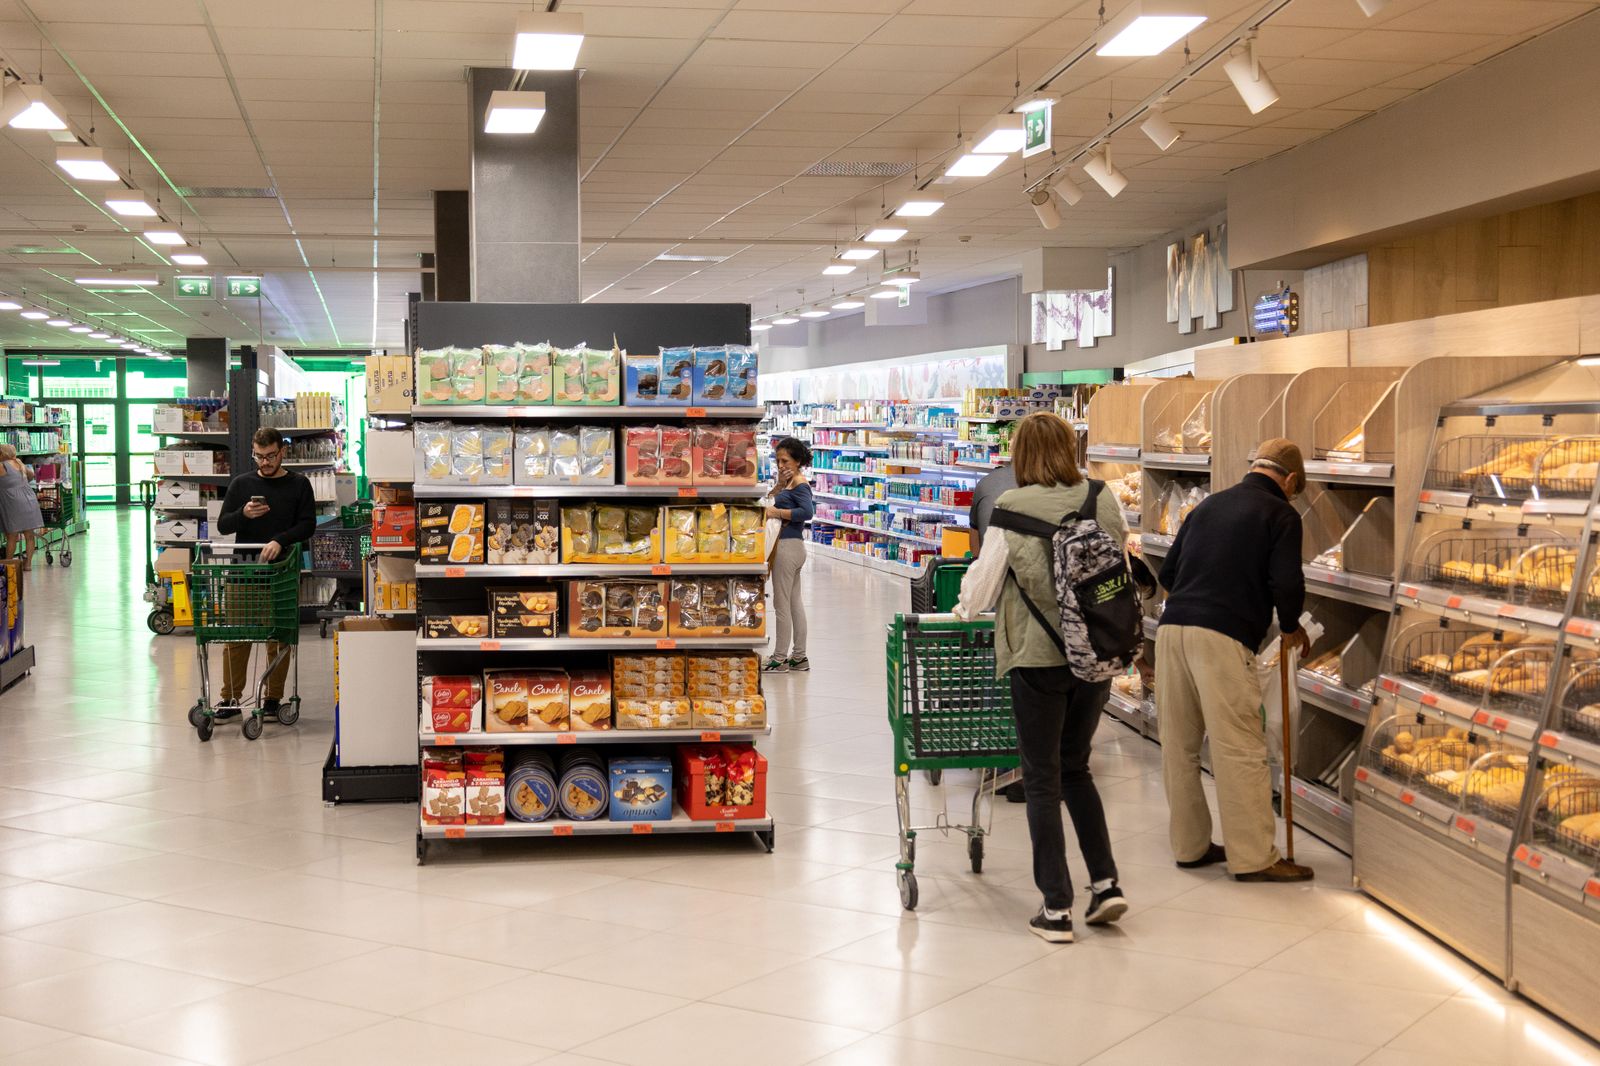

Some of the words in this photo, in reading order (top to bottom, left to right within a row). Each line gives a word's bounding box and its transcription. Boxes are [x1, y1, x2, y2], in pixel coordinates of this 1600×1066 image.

[493, 682, 522, 695] Canela
[531, 683, 564, 696] Canela
[573, 684, 606, 697] Canela
